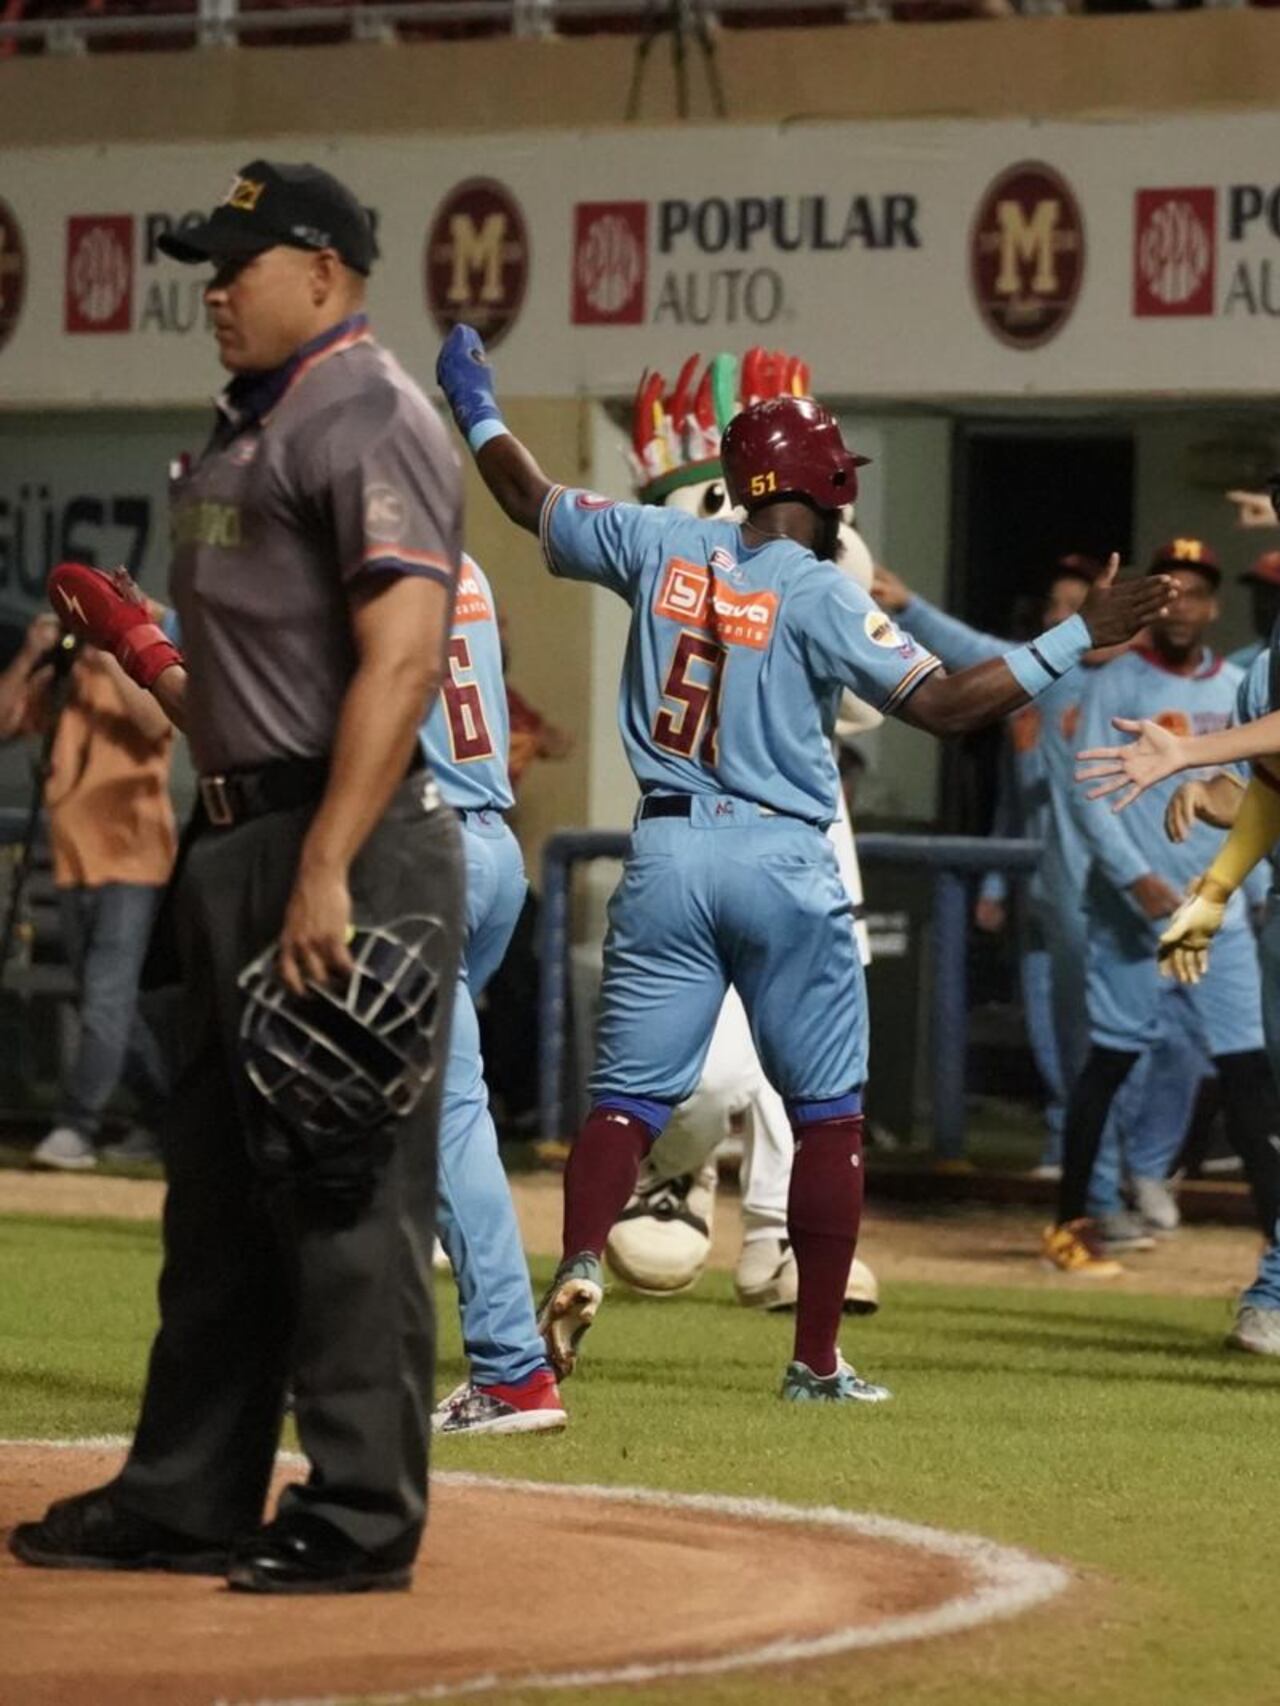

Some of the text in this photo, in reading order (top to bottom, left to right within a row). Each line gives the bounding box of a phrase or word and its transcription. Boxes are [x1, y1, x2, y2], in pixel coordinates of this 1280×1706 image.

[656, 194, 922, 254] POPULAR
[995, 201, 1060, 294] M
[447, 212, 507, 301] M
[652, 267, 784, 325] AUTO
[751, 471, 777, 497] 51
[1173, 538, 1202, 561] M
